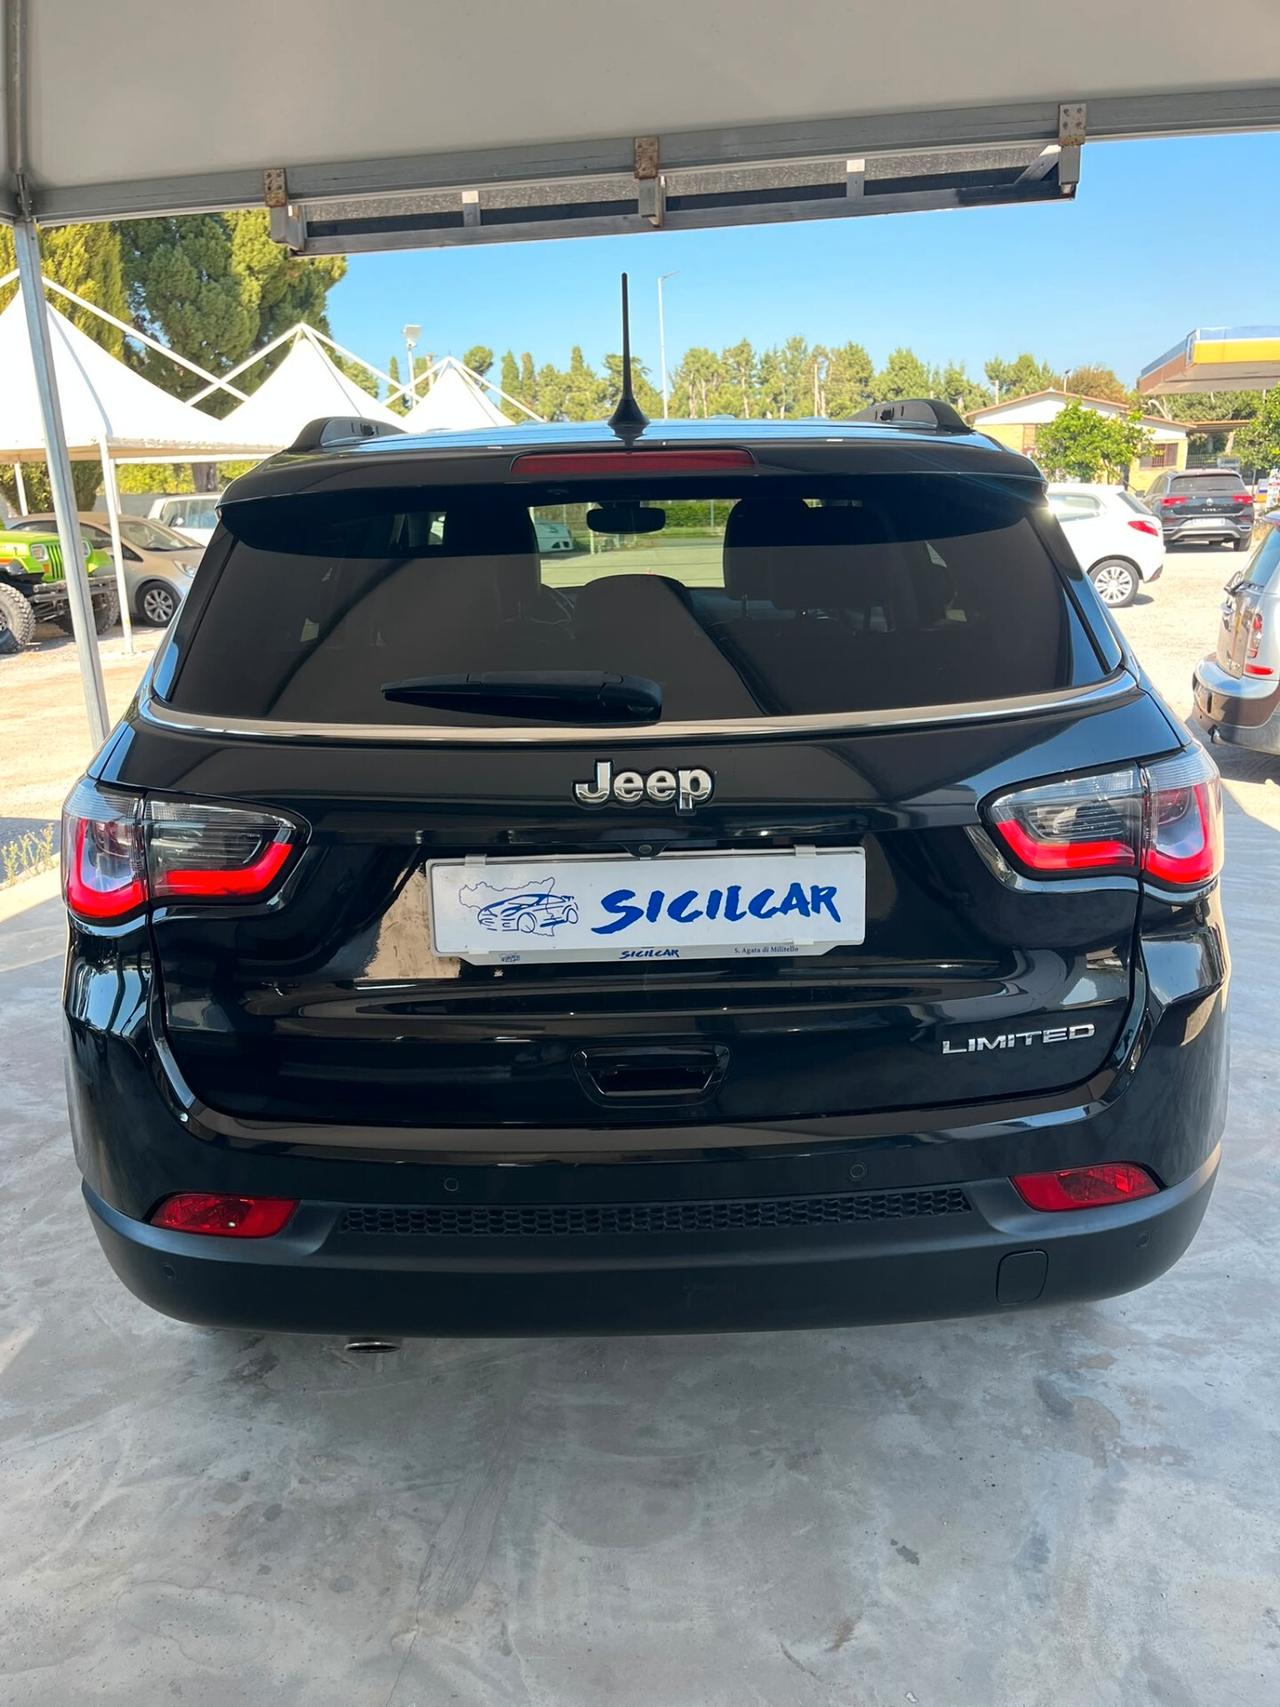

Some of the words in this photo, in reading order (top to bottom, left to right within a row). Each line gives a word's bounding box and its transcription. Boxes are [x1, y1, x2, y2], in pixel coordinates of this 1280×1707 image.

[575, 761, 712, 810] Jeep
[591, 882, 841, 934] SICILCAR
[619, 948, 680, 960] SICILCAR
[742, 947, 761, 955] Agata
[770, 945, 799, 953] Militello
[942, 1023, 1096, 1054] LIMITED
